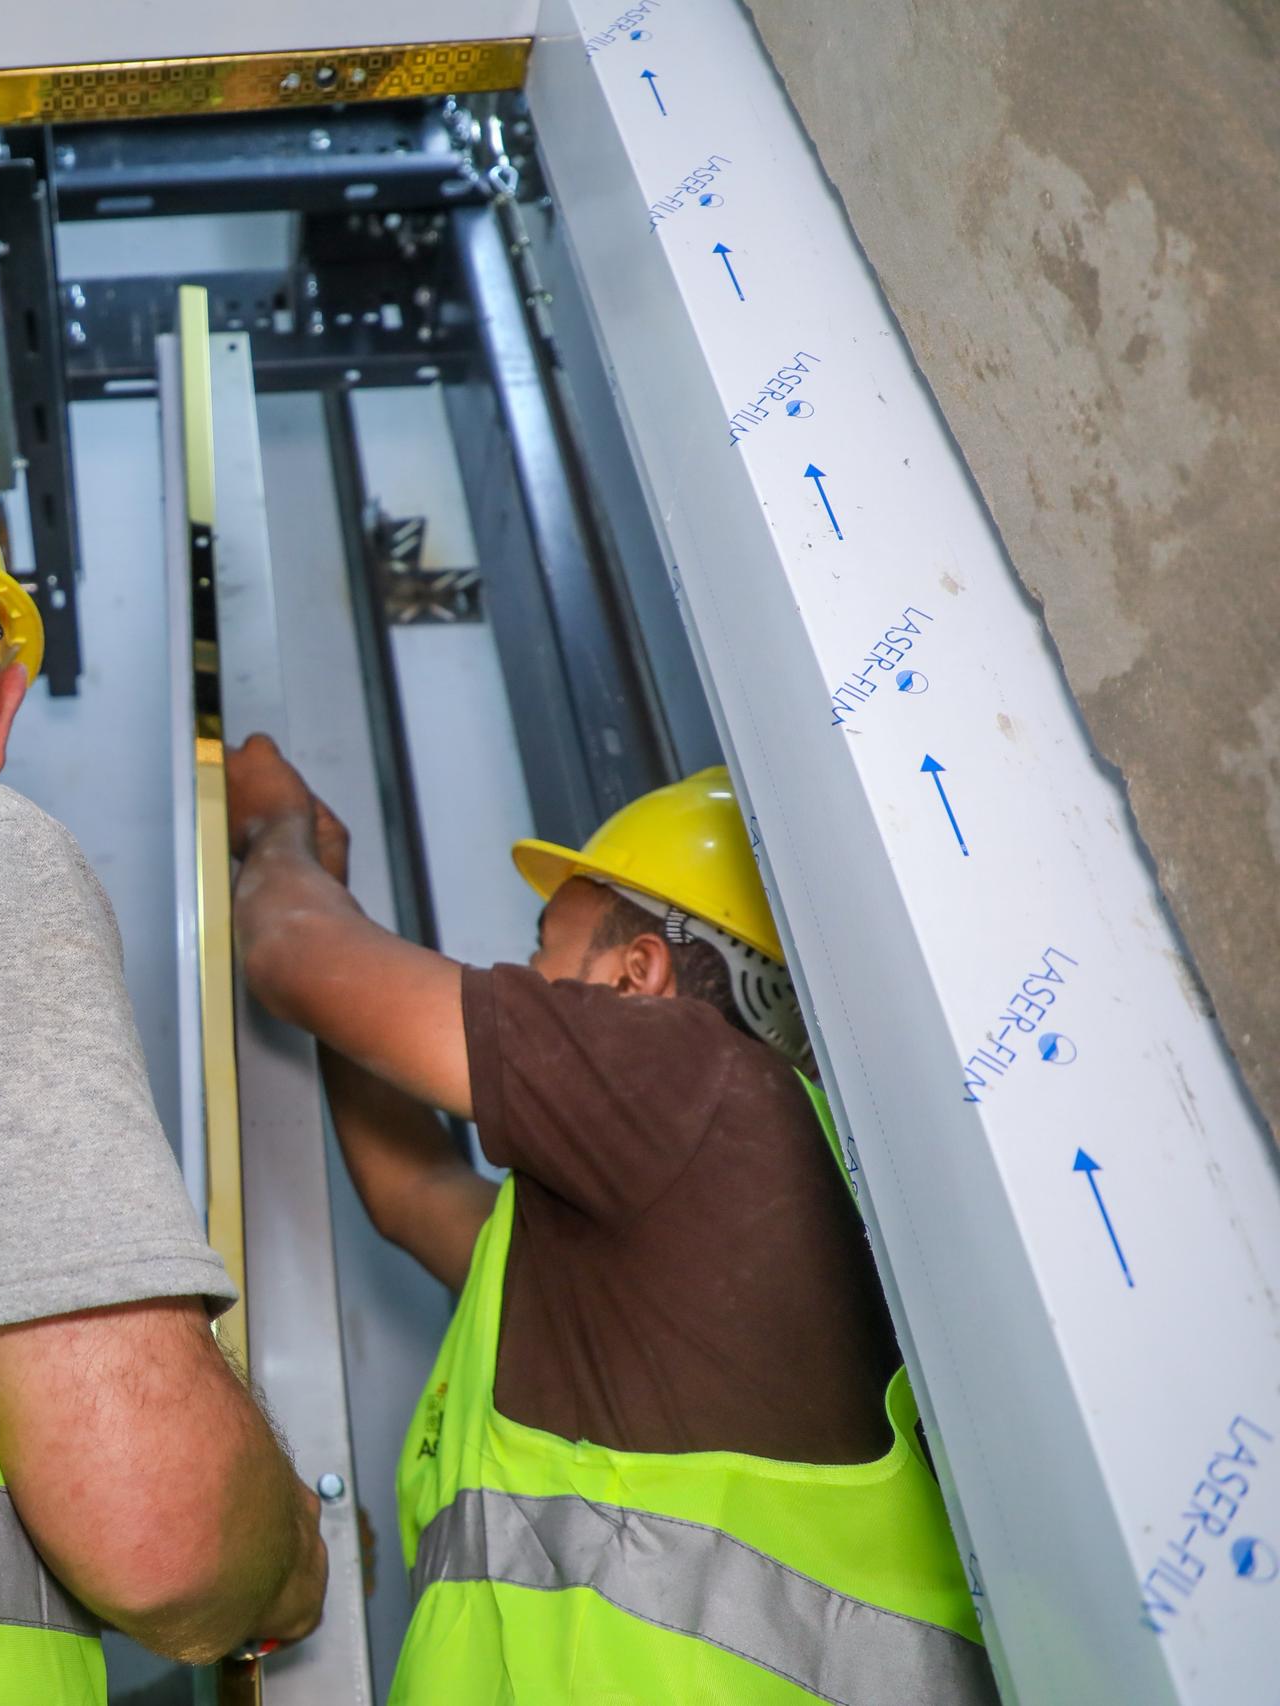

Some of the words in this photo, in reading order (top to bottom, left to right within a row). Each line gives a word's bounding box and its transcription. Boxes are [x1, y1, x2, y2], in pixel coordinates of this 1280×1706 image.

[586, 0, 661, 66] LASER-FILM
[649, 154, 732, 234] LASER-FILM
[729, 351, 821, 447] LASER-FILM
[831, 606, 934, 727] LASER-FILM
[963, 946, 1078, 1104] LASER-FILM
[1139, 1415, 1273, 1635] LASER-FILM
